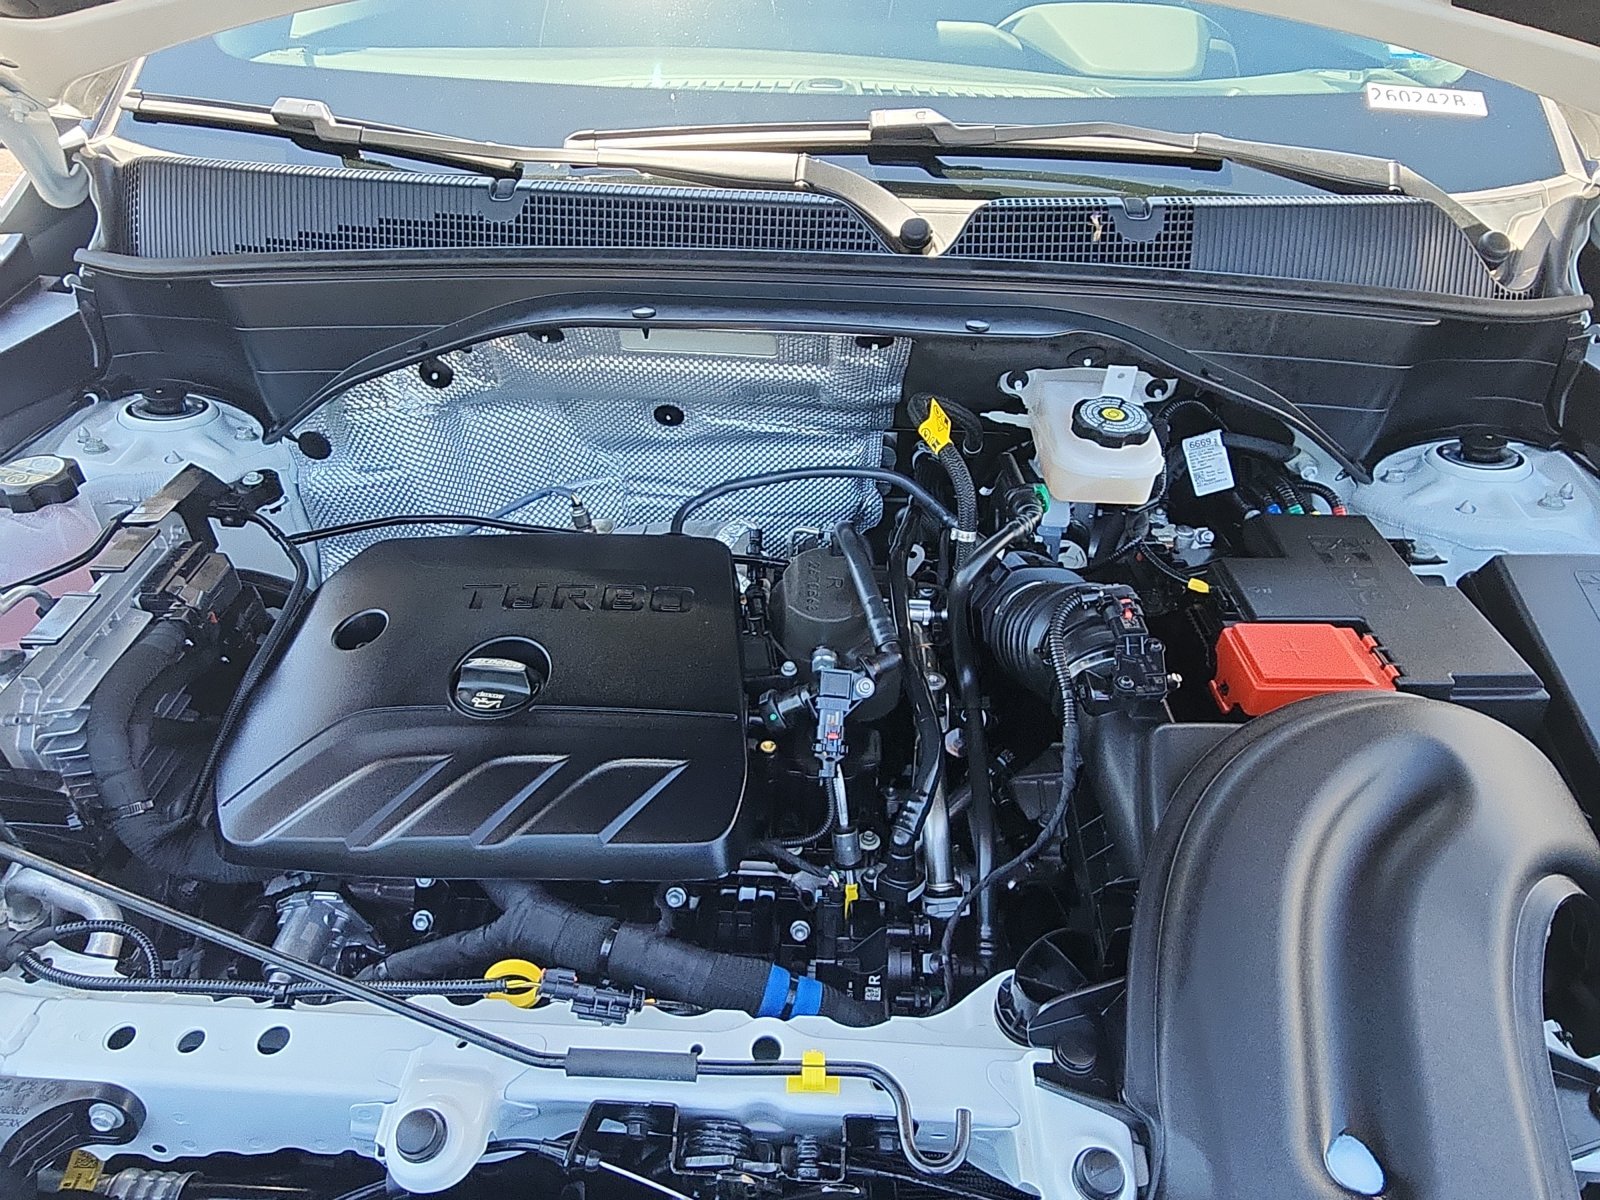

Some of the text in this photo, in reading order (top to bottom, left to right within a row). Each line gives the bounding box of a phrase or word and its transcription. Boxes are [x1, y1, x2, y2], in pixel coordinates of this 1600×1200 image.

[1189, 437, 1212, 449] 6669
[462, 582, 695, 613] TURBO
[868, 974, 881, 986] R
